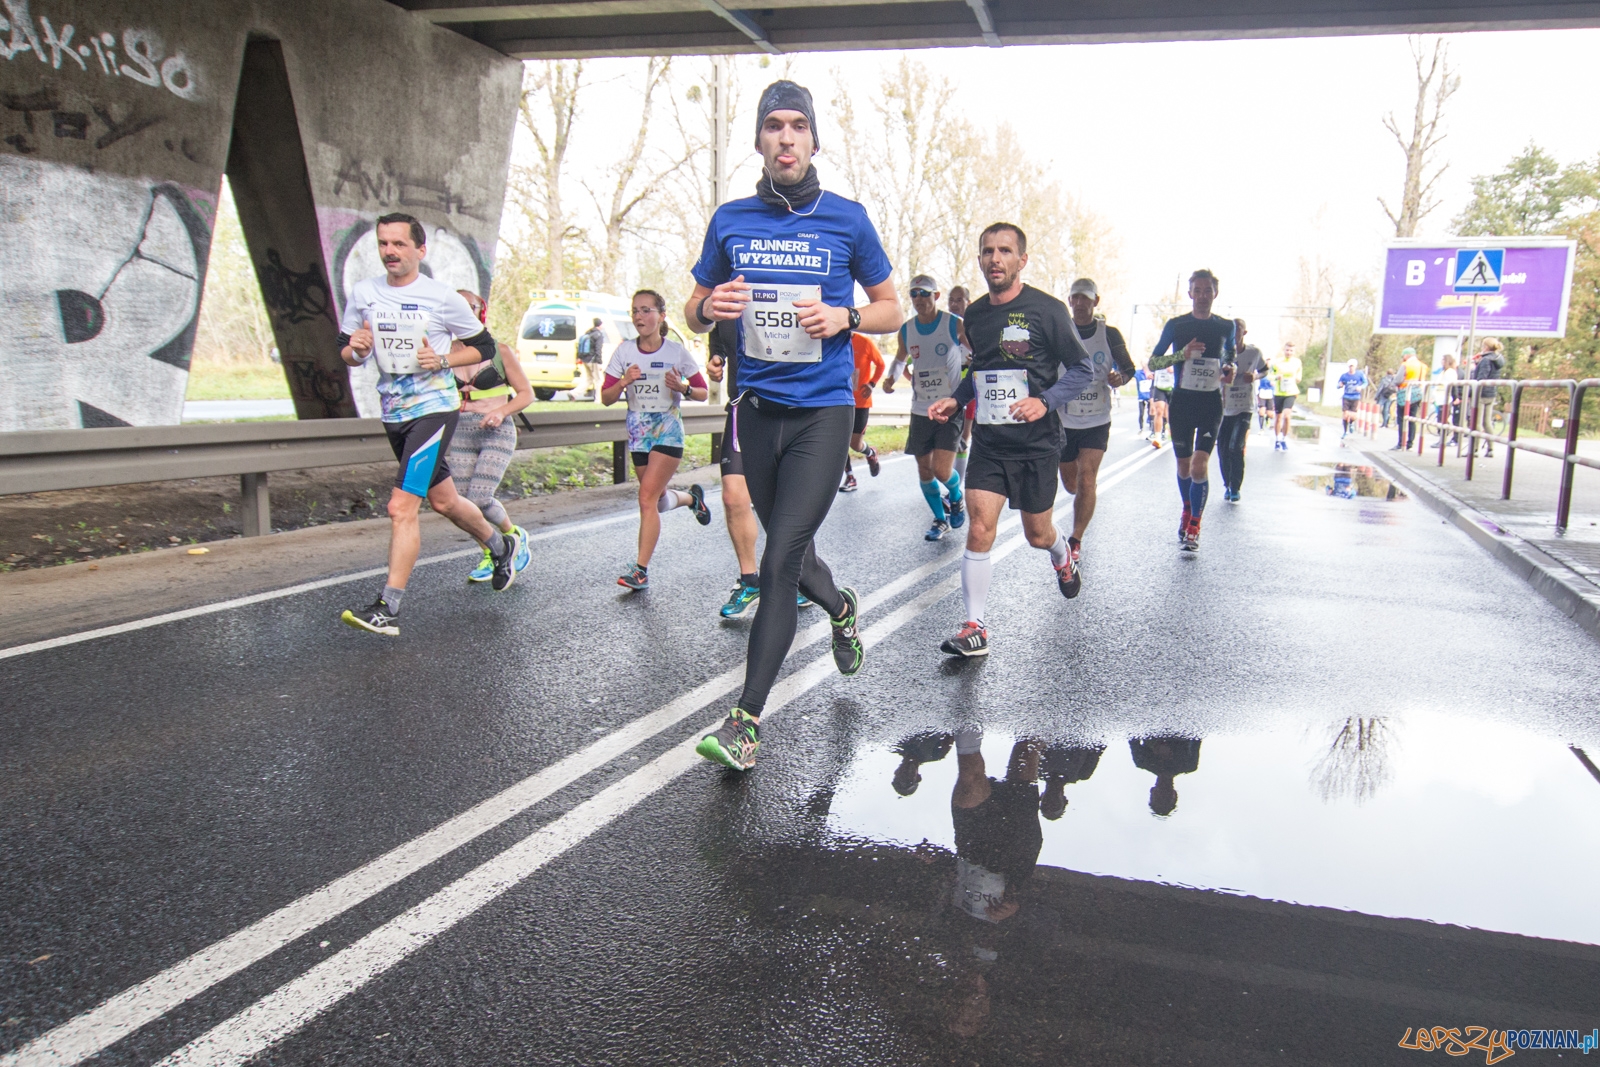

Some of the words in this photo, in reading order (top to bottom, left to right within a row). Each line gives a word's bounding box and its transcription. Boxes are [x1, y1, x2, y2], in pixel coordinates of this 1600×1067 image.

[739, 252, 822, 268] WYZWANIE
[399, 312, 424, 320] TATY
[755, 310, 799, 328] 5581
[764, 331, 790, 340] Michał
[381, 337, 414, 350] 1725
[1191, 368, 1215, 377] 3562
[634, 384, 660, 394] 1724
[920, 378, 942, 389] 3042
[984, 388, 1017, 401] 4934
